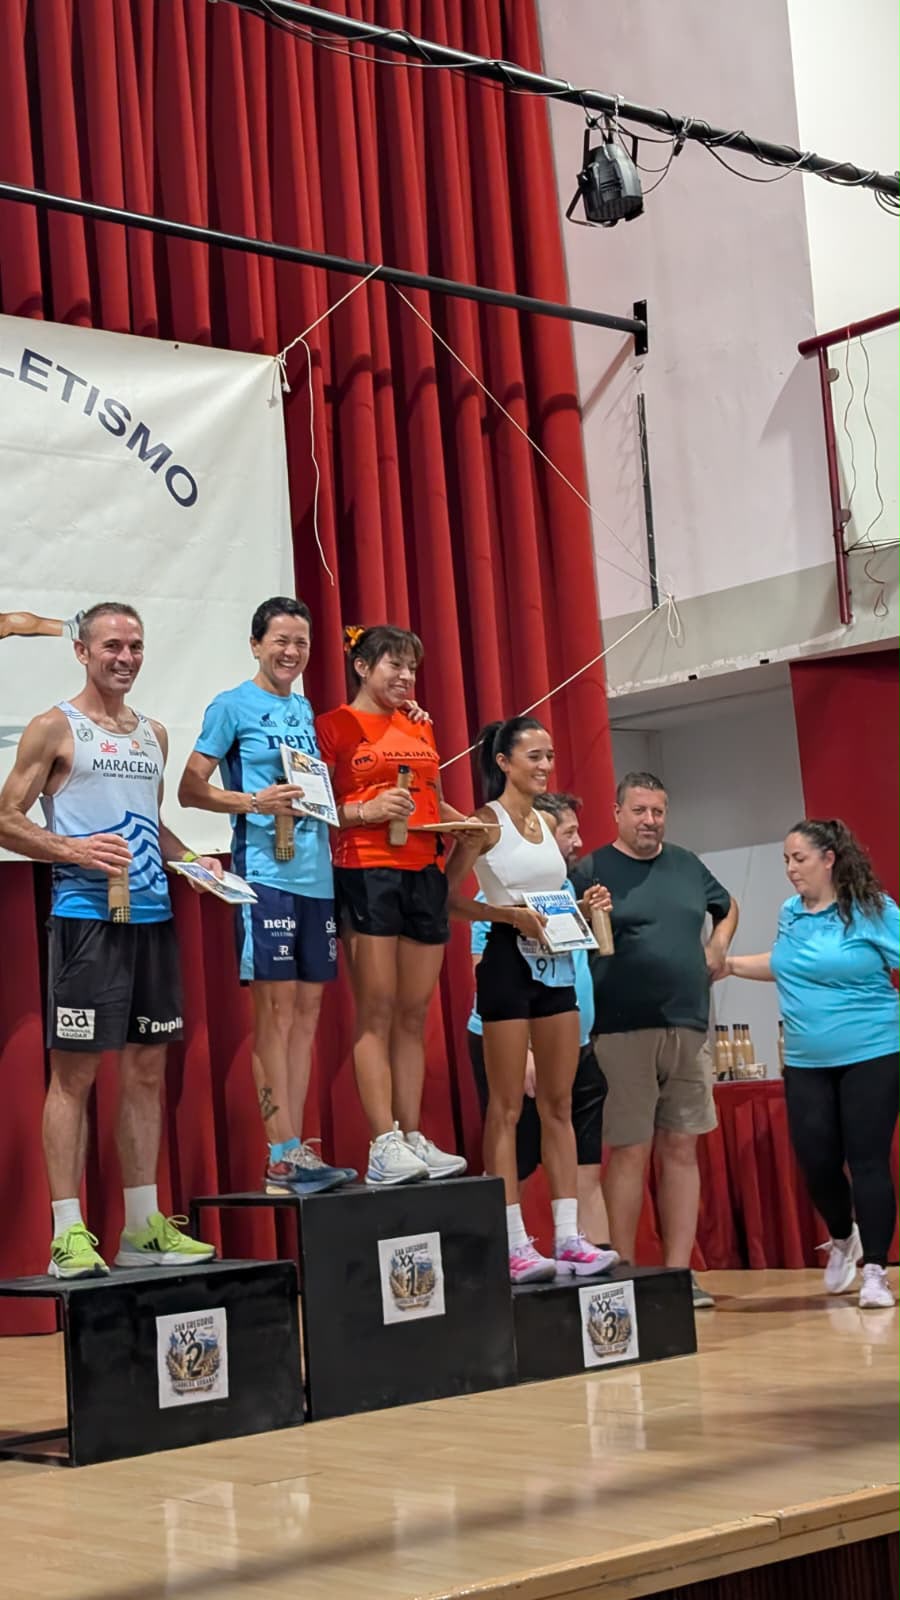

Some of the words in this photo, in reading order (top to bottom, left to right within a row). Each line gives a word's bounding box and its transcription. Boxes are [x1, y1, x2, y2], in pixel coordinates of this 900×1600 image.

[92, 758, 160, 775] MARACENA
[263, 916, 296, 931] nerja
[400, 1253, 415, 1268] XX
[407, 1264, 417, 1296] 1
[596, 1298, 612, 1314] XX
[174, 1322, 186, 1333] SAN
[186, 1315, 214, 1329] GREGORIO
[603, 1311, 617, 1342] 3
[180, 1328, 197, 1345] XX
[185, 1341, 203, 1378] 2
